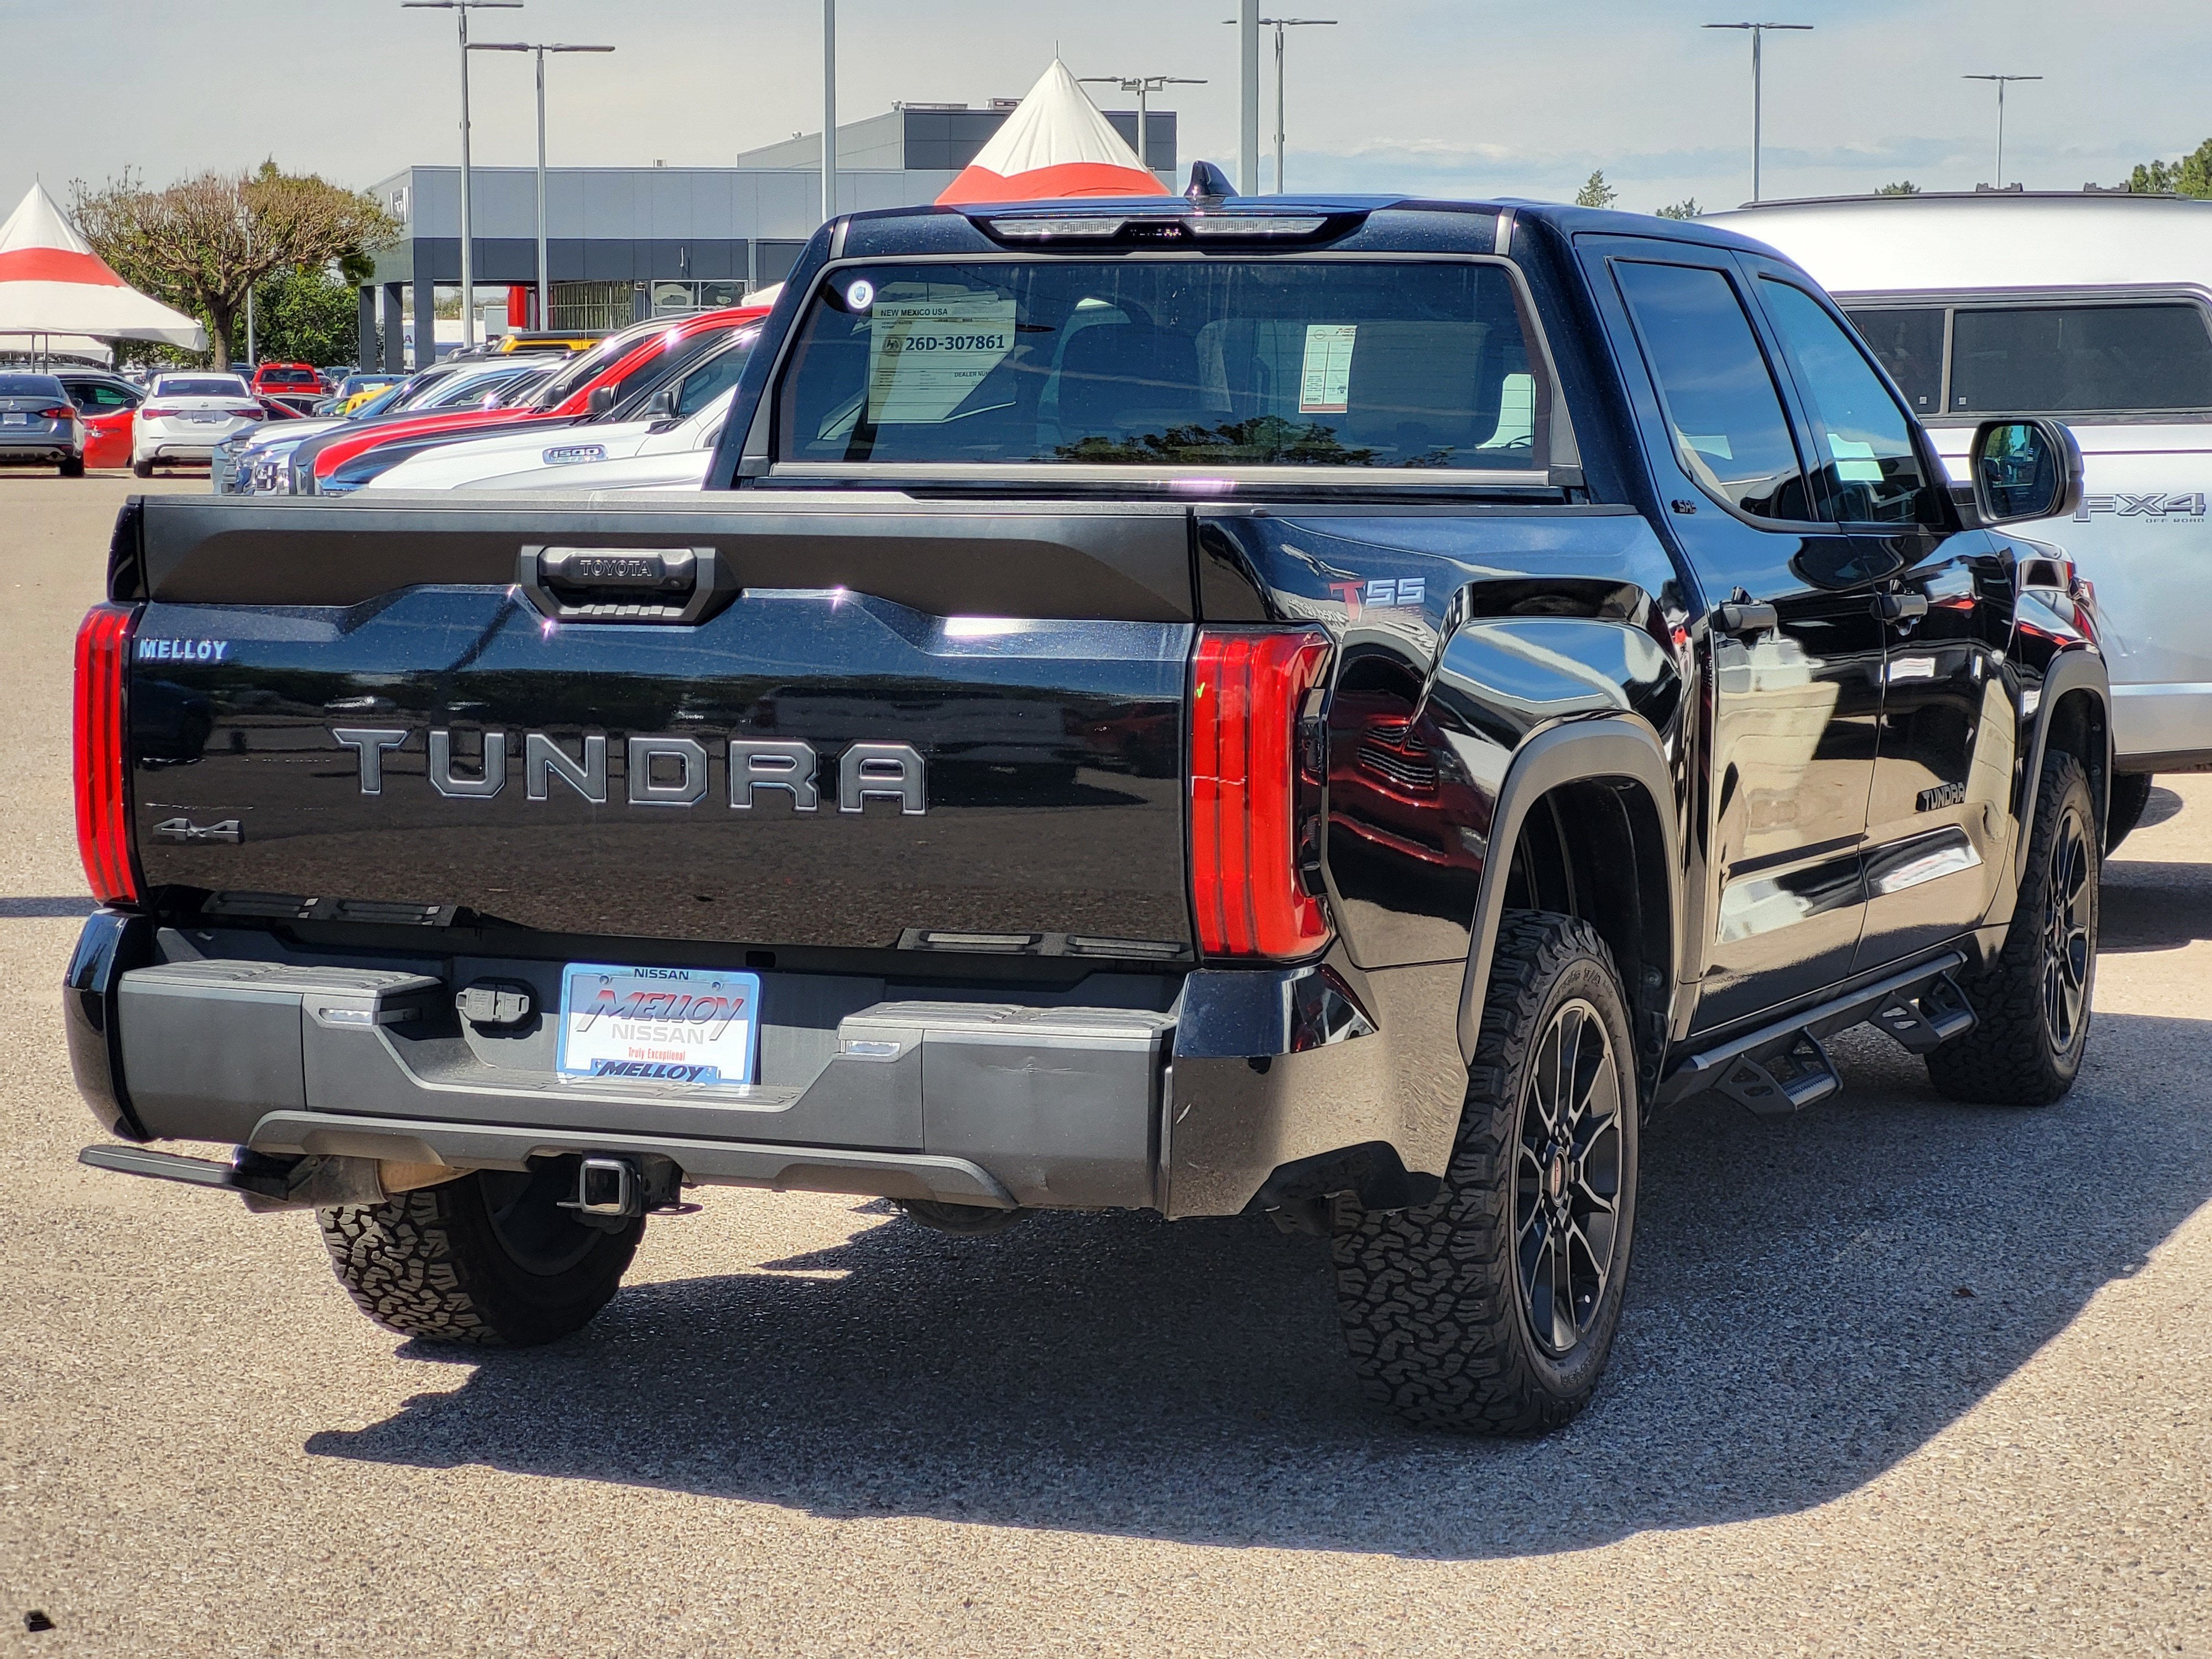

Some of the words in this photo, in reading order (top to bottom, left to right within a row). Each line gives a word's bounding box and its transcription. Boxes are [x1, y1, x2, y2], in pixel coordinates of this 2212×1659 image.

[905, 335, 1004, 351] 26D-307861
[553, 448, 599, 458] 1500
[2073, 493, 2206, 523] FX4
[580, 560, 652, 577] TOYOTA
[139, 639, 228, 659] MELLOY
[332, 727, 927, 816] TUNDRA
[1922, 782, 1965, 811] TUNDRA
[634, 968, 689, 980] NISSAN
[576, 990, 744, 1041] MELLOY
[612, 1024, 704, 1045] NISSAN
[629, 1047, 645, 1060] Truly
[648, 1048, 685, 1061] Exceptional
[596, 1061, 705, 1082] MELLOY
